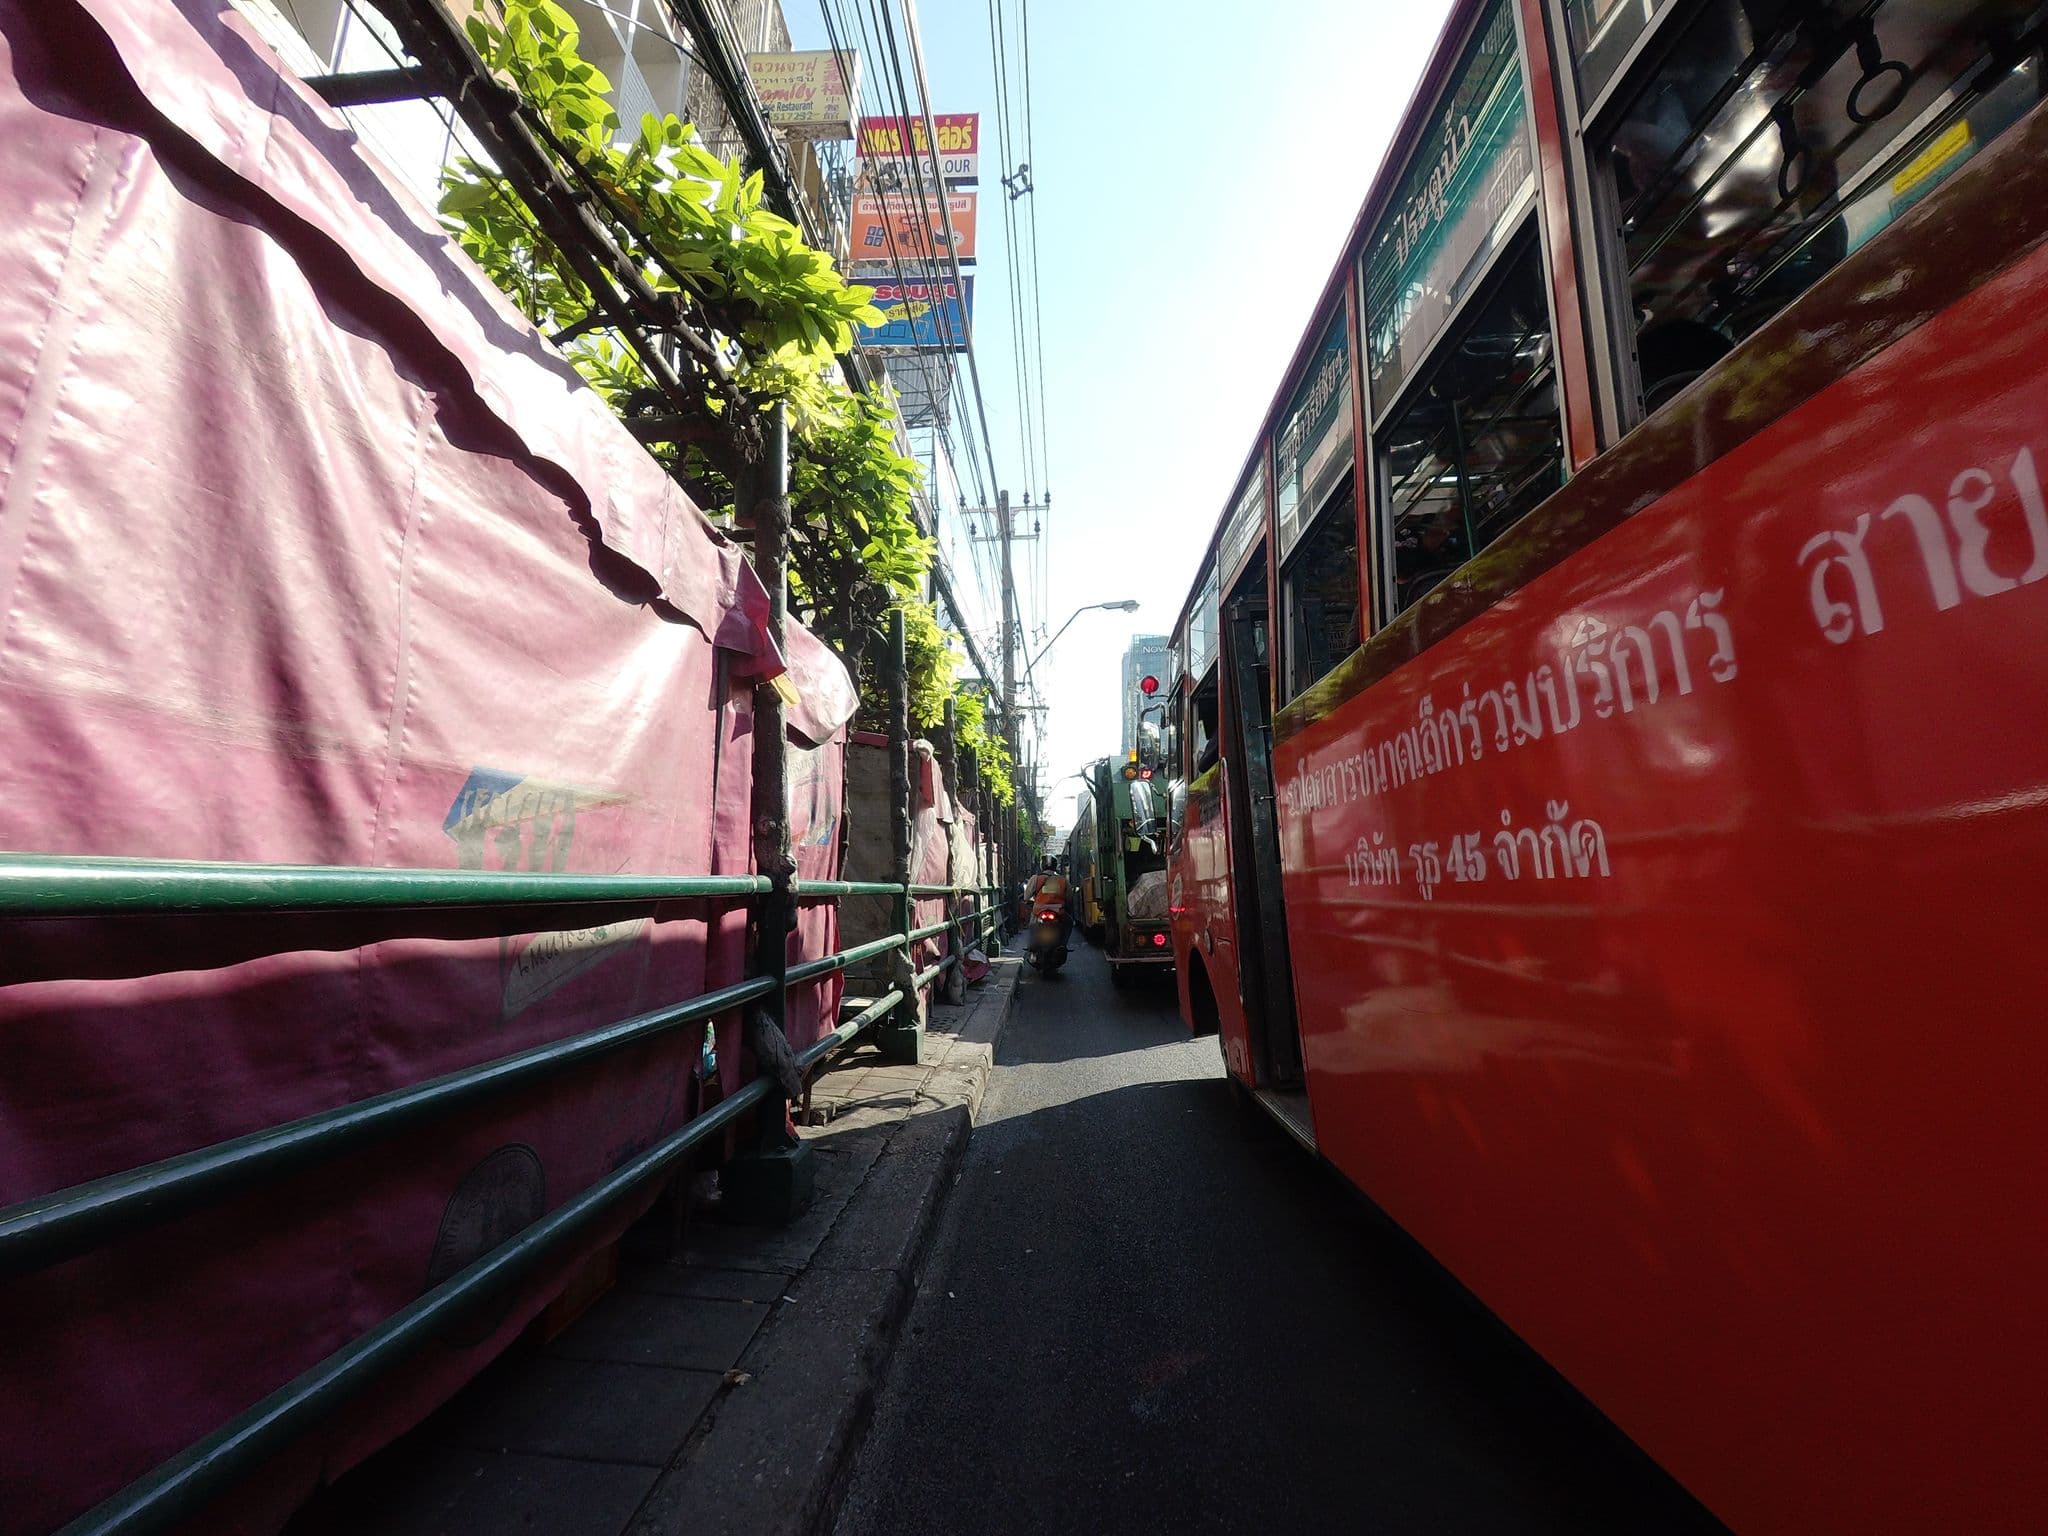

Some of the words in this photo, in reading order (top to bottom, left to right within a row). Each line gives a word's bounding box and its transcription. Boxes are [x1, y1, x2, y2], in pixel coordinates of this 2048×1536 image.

[776, 102, 814, 111] Restaurant
[922, 159, 971, 175] COUR
[1395, 100, 1470, 263] ประตูน้ำ
[1797, 446, 2048, 644] สาย
[1345, 832, 1400, 887] บริษัท
[1446, 830, 1487, 883] 45
[1493, 799, 1611, 881] จำกัด
